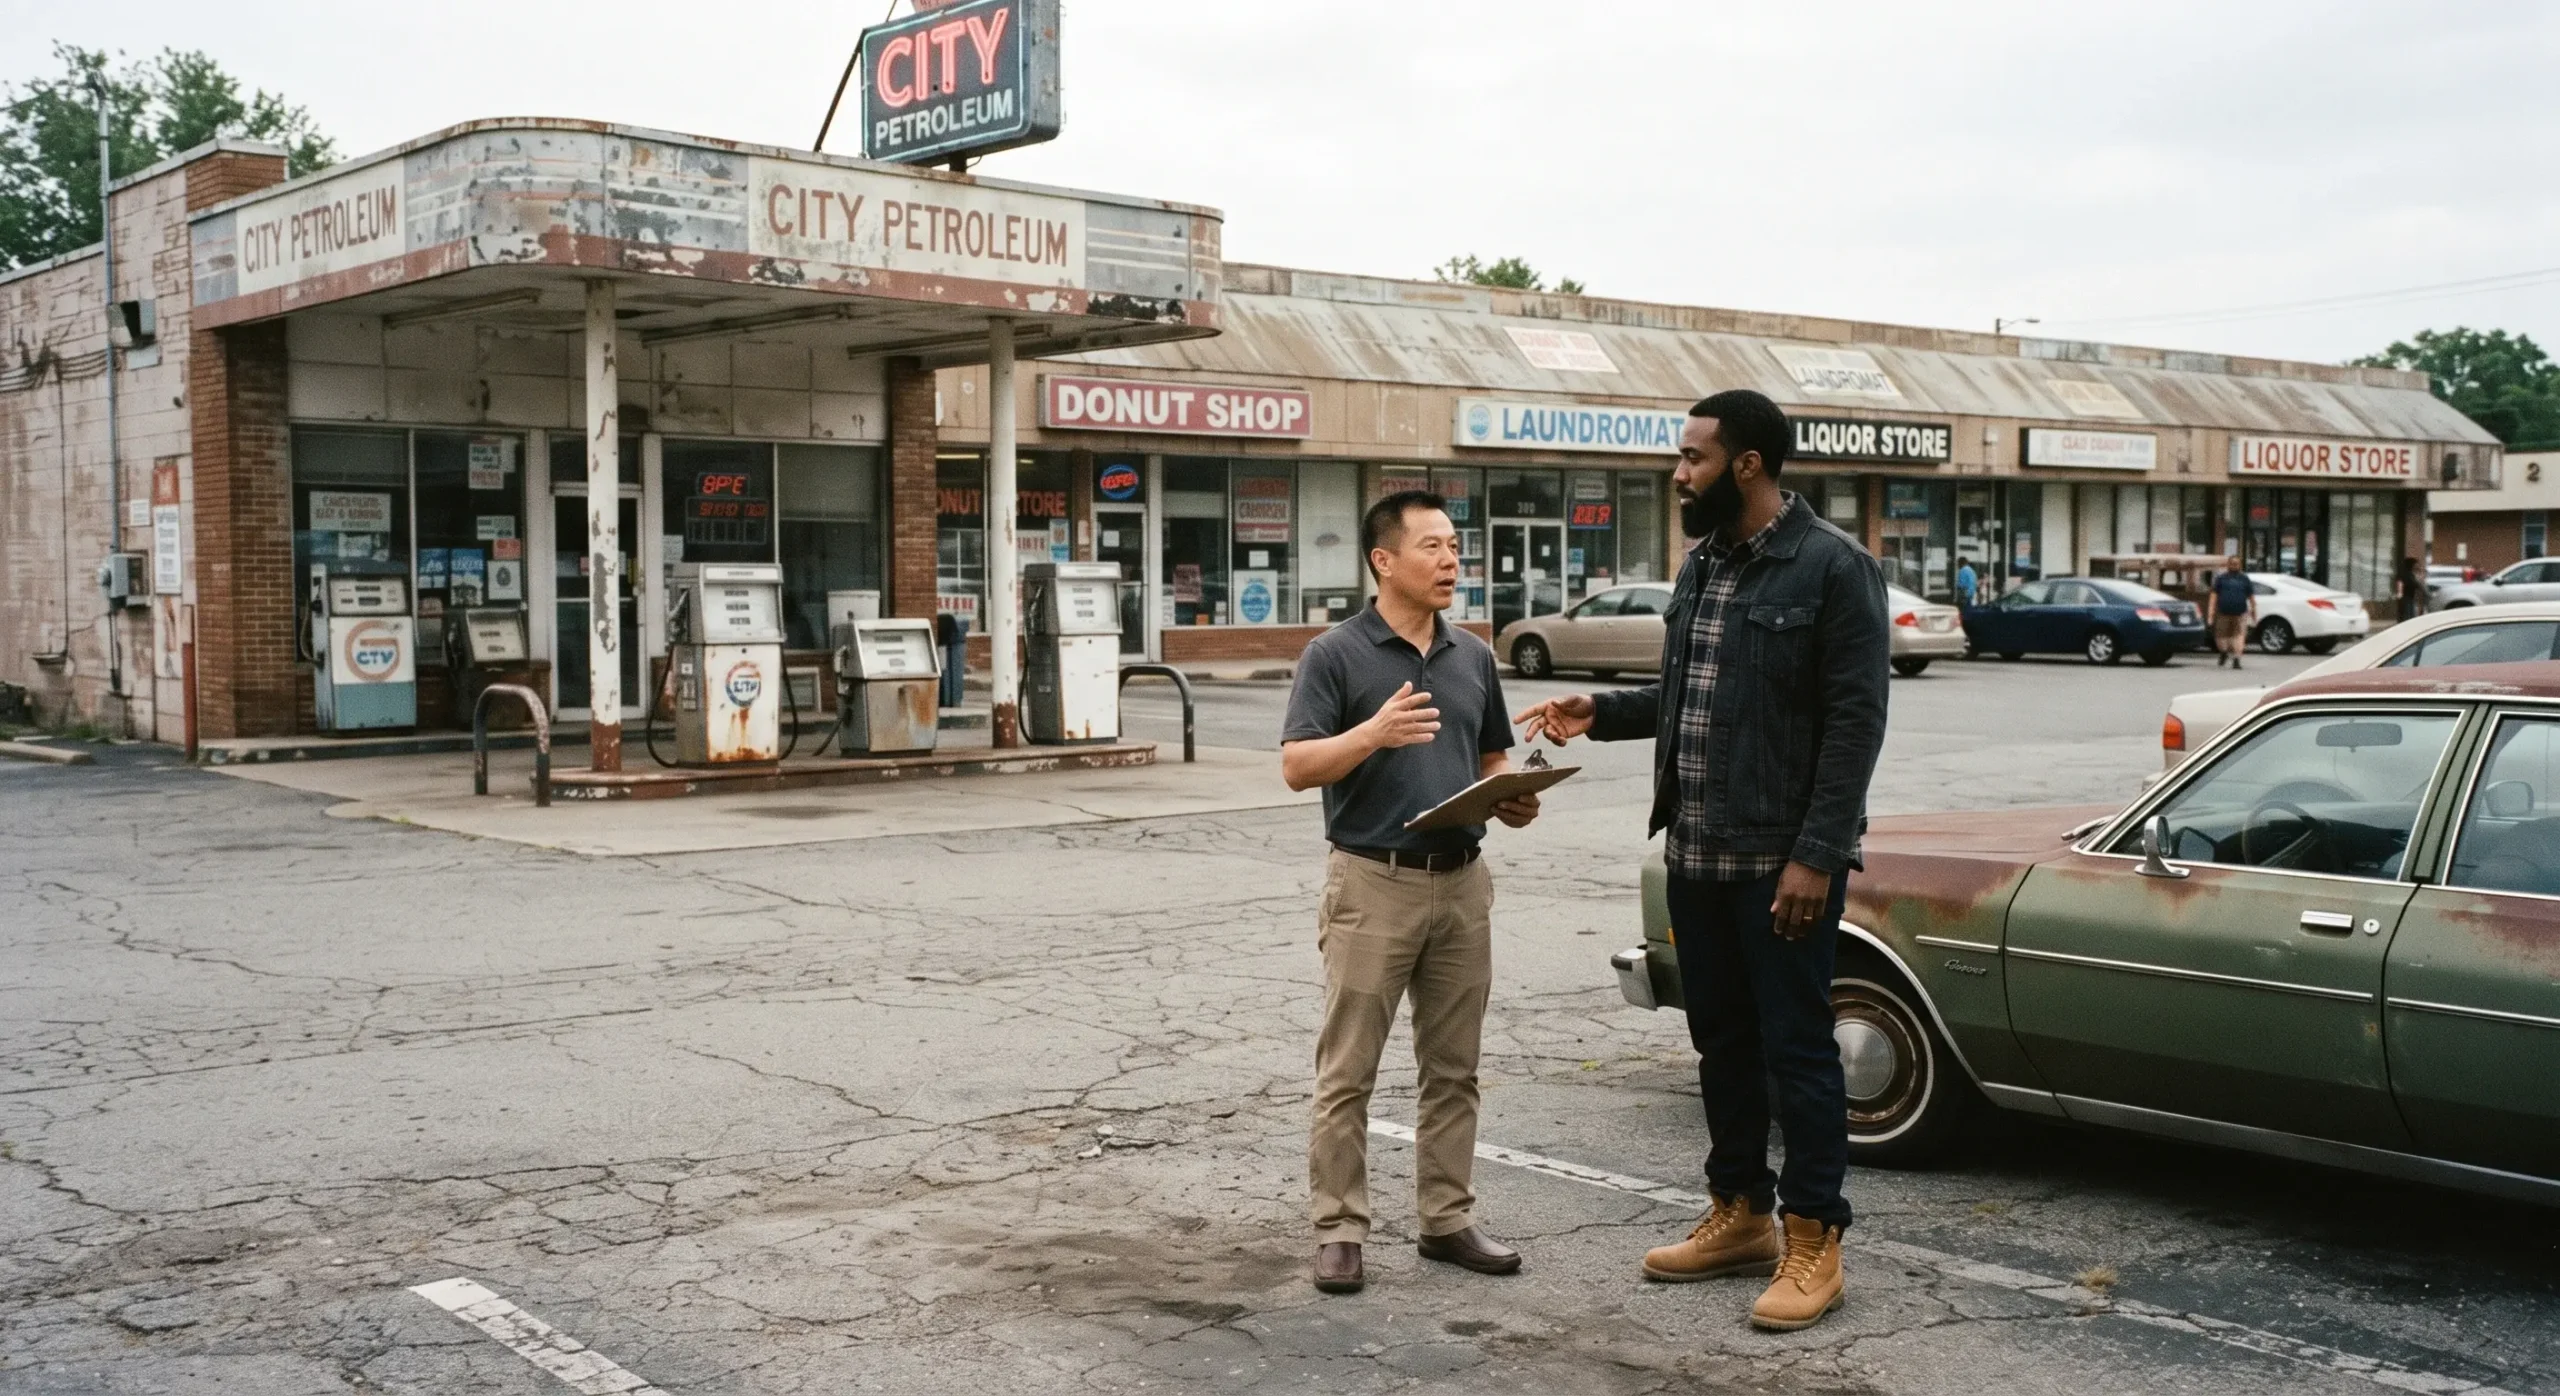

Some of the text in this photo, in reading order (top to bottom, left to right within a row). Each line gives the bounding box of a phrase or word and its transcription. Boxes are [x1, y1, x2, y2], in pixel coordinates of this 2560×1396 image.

[877, 8, 1008, 107] CITY
[875, 88, 1013, 149] PETROLEUM
[244, 184, 396, 273] CITY PETROLEUM
[768, 184, 1067, 268] CITY PETROLEUM
[1058, 384, 1303, 431] DONUT SHOP
[1502, 407, 1685, 446] LAUNDROMAT
[1796, 422, 1948, 458] LIQUOR STORE
[2243, 441, 2411, 475] LIQUOR STORE
[2527, 462, 2540, 482] 2
[1016, 490, 1066, 517] TORE
